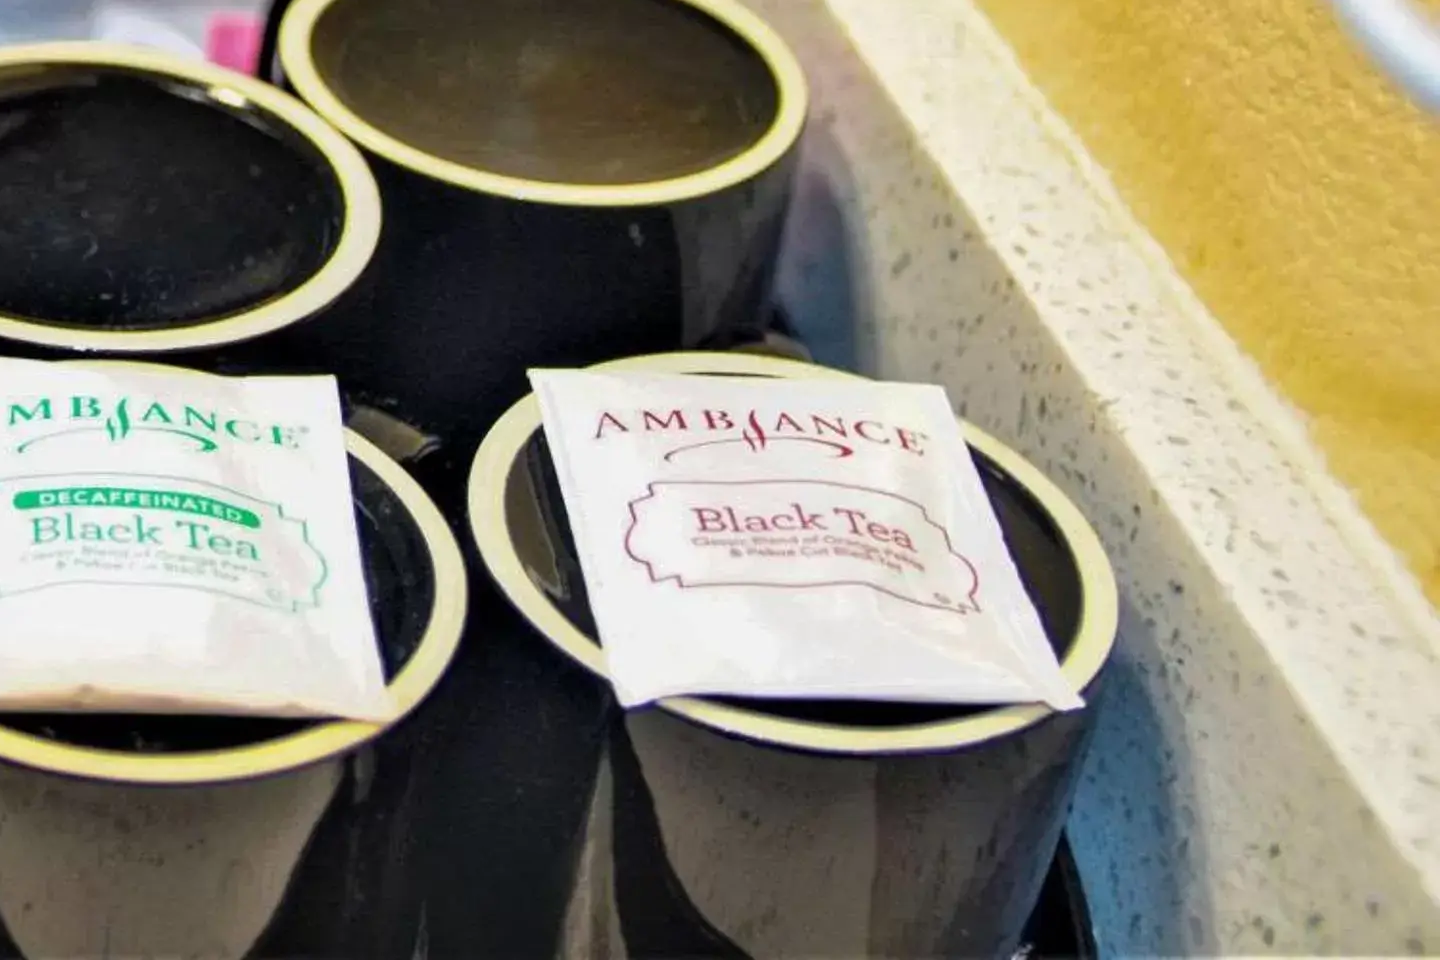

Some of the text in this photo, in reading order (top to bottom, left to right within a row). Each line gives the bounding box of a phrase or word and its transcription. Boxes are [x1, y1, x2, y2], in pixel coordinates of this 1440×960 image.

[596, 408, 924, 457] AMBIANCE
[38, 490, 243, 522] DECAFFEINATED
[691, 503, 918, 553] Black Tea
[30, 513, 261, 561] Black Tea
